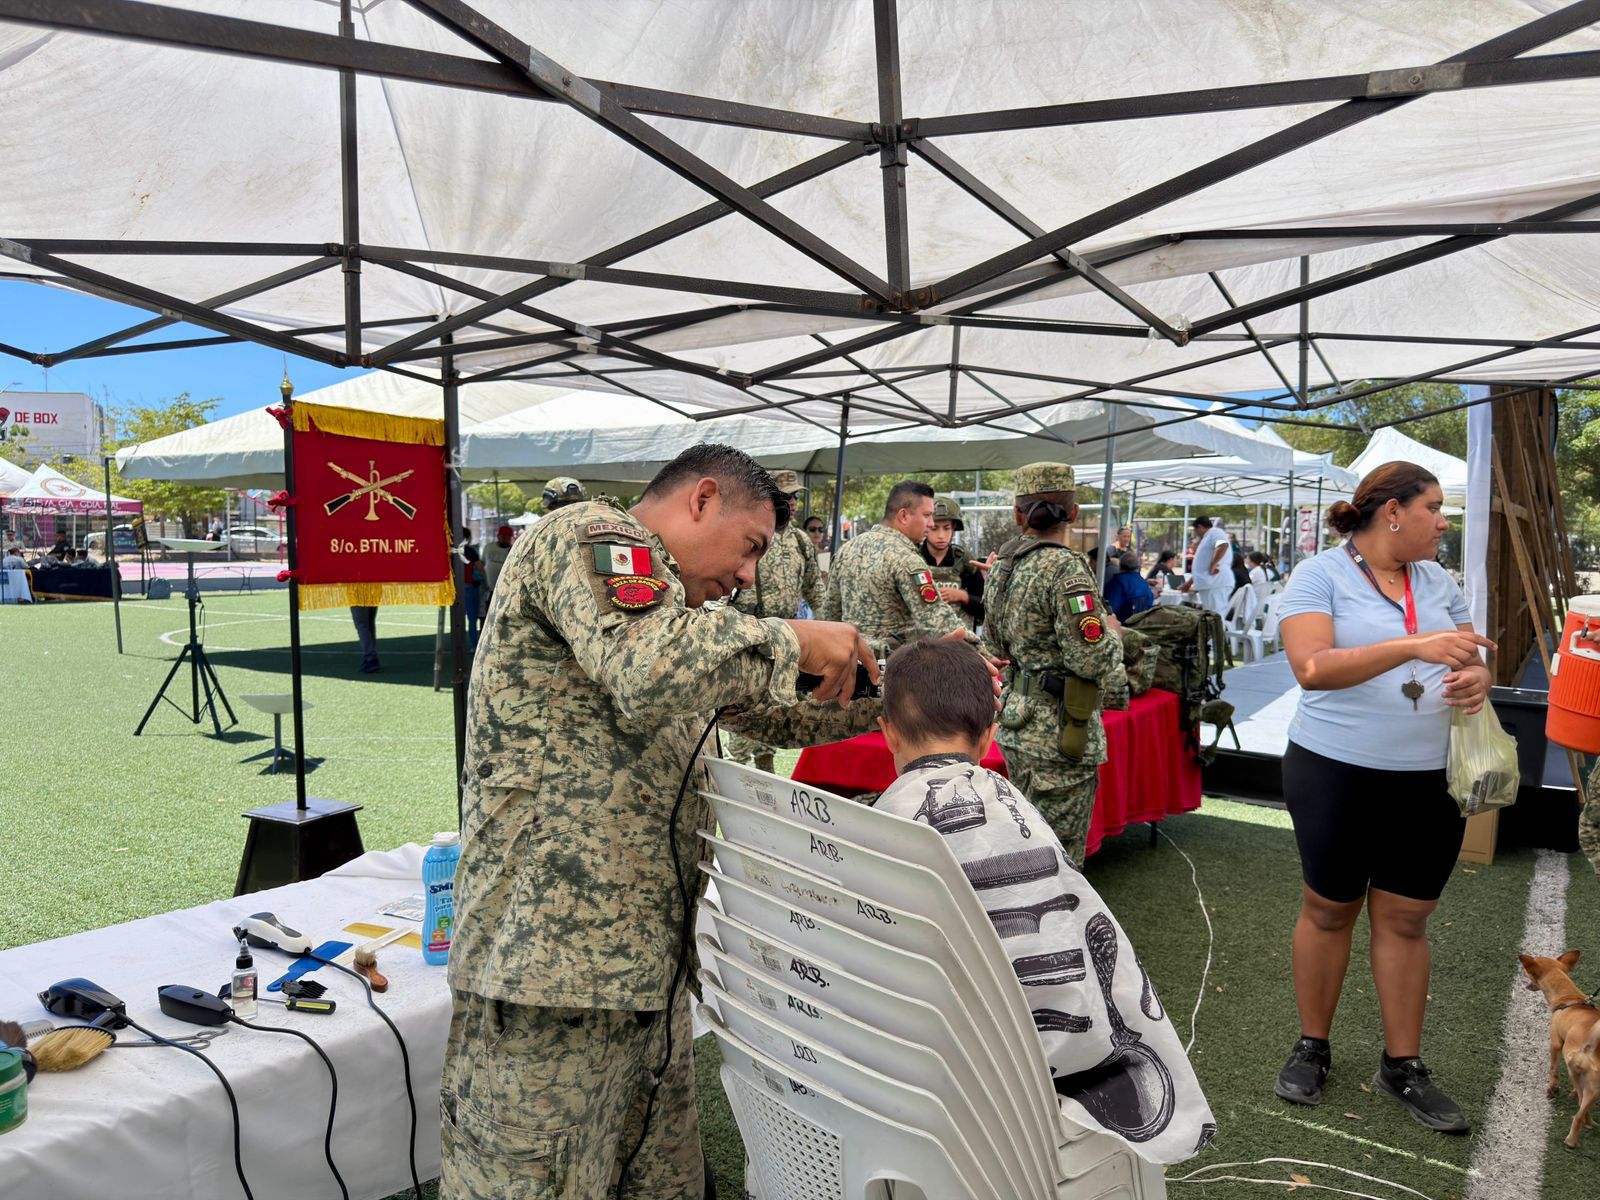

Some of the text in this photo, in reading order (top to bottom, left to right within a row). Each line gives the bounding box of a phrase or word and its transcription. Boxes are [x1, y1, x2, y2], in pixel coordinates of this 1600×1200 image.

[14, 411, 58, 424] DE BOX
[589, 524, 642, 537] MEXICO
[360, 538, 393, 553] BTN.
[394, 538, 419, 553] INF.
[790, 788, 835, 826] ARB.
[810, 833, 844, 862] ARB.
[789, 910, 821, 932] ARB.
[857, 899, 897, 925] ARB.
[789, 957, 830, 988] ARB.
[787, 994, 823, 1019] ARB.
